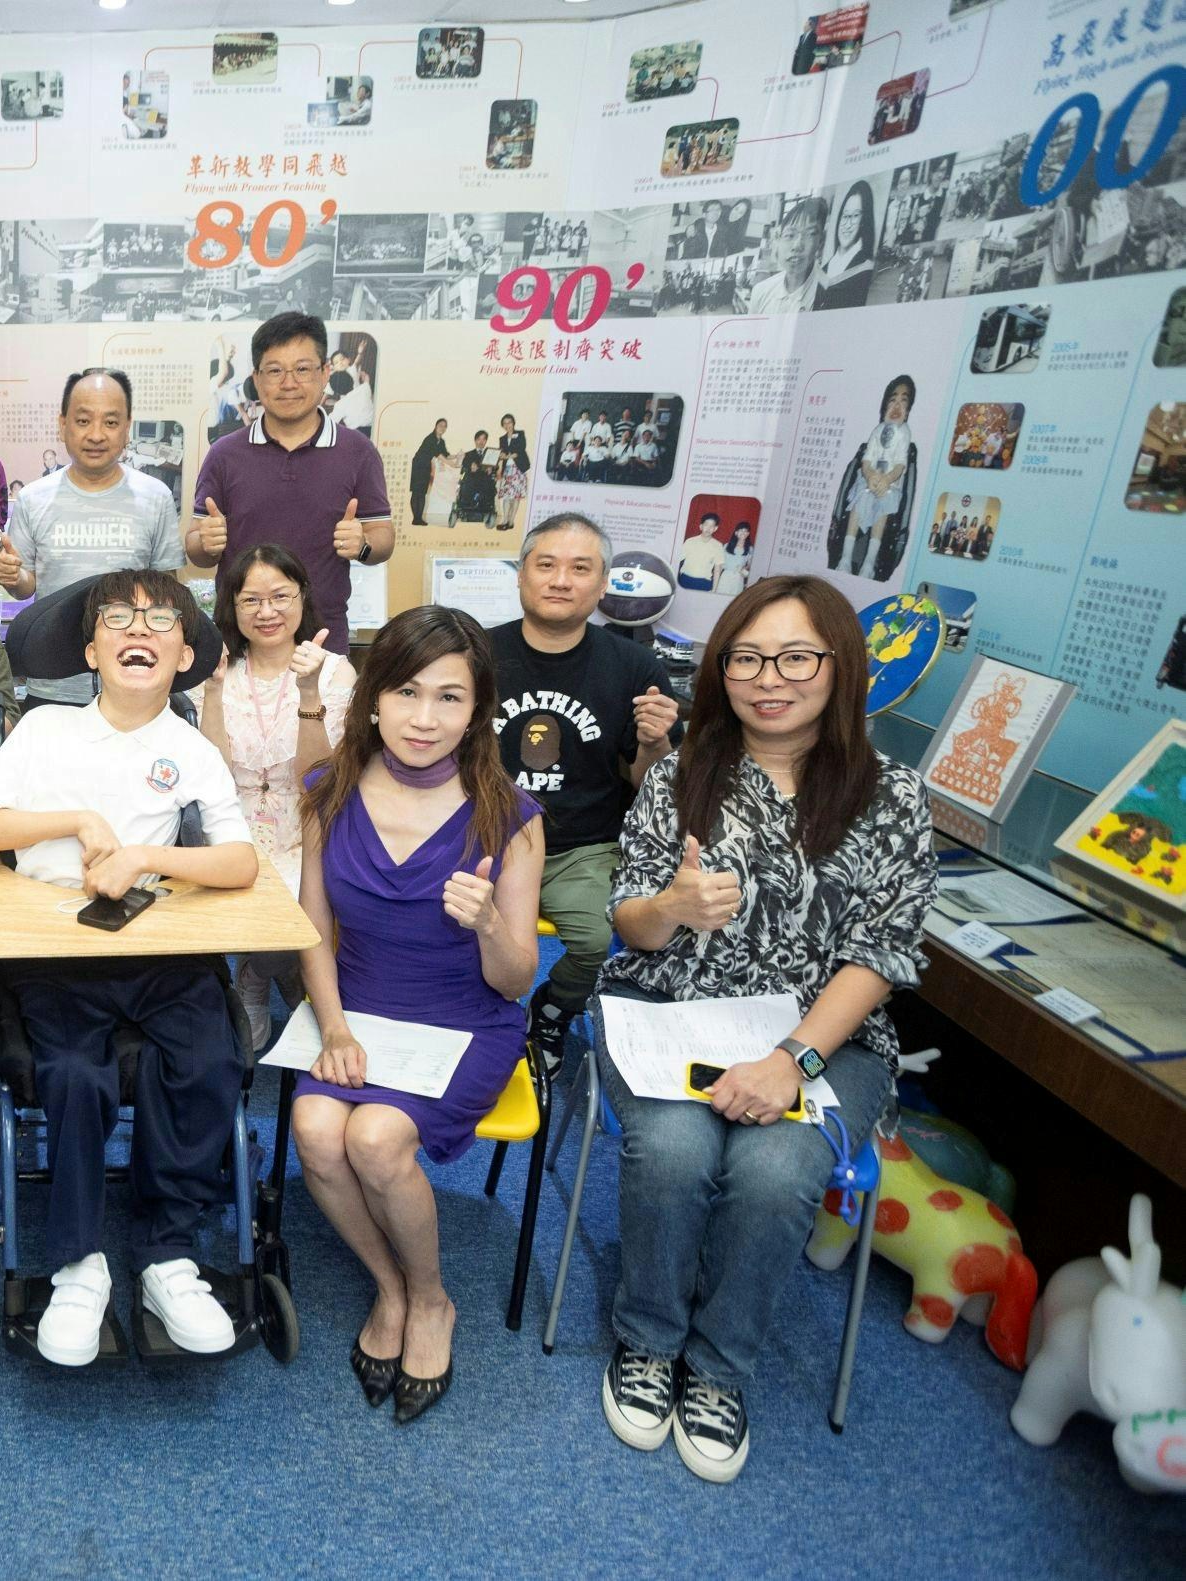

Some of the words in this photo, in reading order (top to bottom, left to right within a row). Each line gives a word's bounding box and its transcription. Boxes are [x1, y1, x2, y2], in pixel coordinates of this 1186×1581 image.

[186, 153, 350, 178] 革新教學同飛越
[184, 183, 216, 194] Flying
[218, 182, 238, 192] with
[283, 181, 327, 192] Teaching
[483, 338, 643, 361] 飛越限制齊突破
[479, 365, 510, 375] Flying
[512, 364, 546, 375] Beyond
[548, 364, 578, 374] Limits
[54, 523, 131, 547] RUNNER
[458, 568, 508, 576] CERTIFICATE
[501, 690, 602, 743] BATHING
[515, 771, 565, 791] APE
